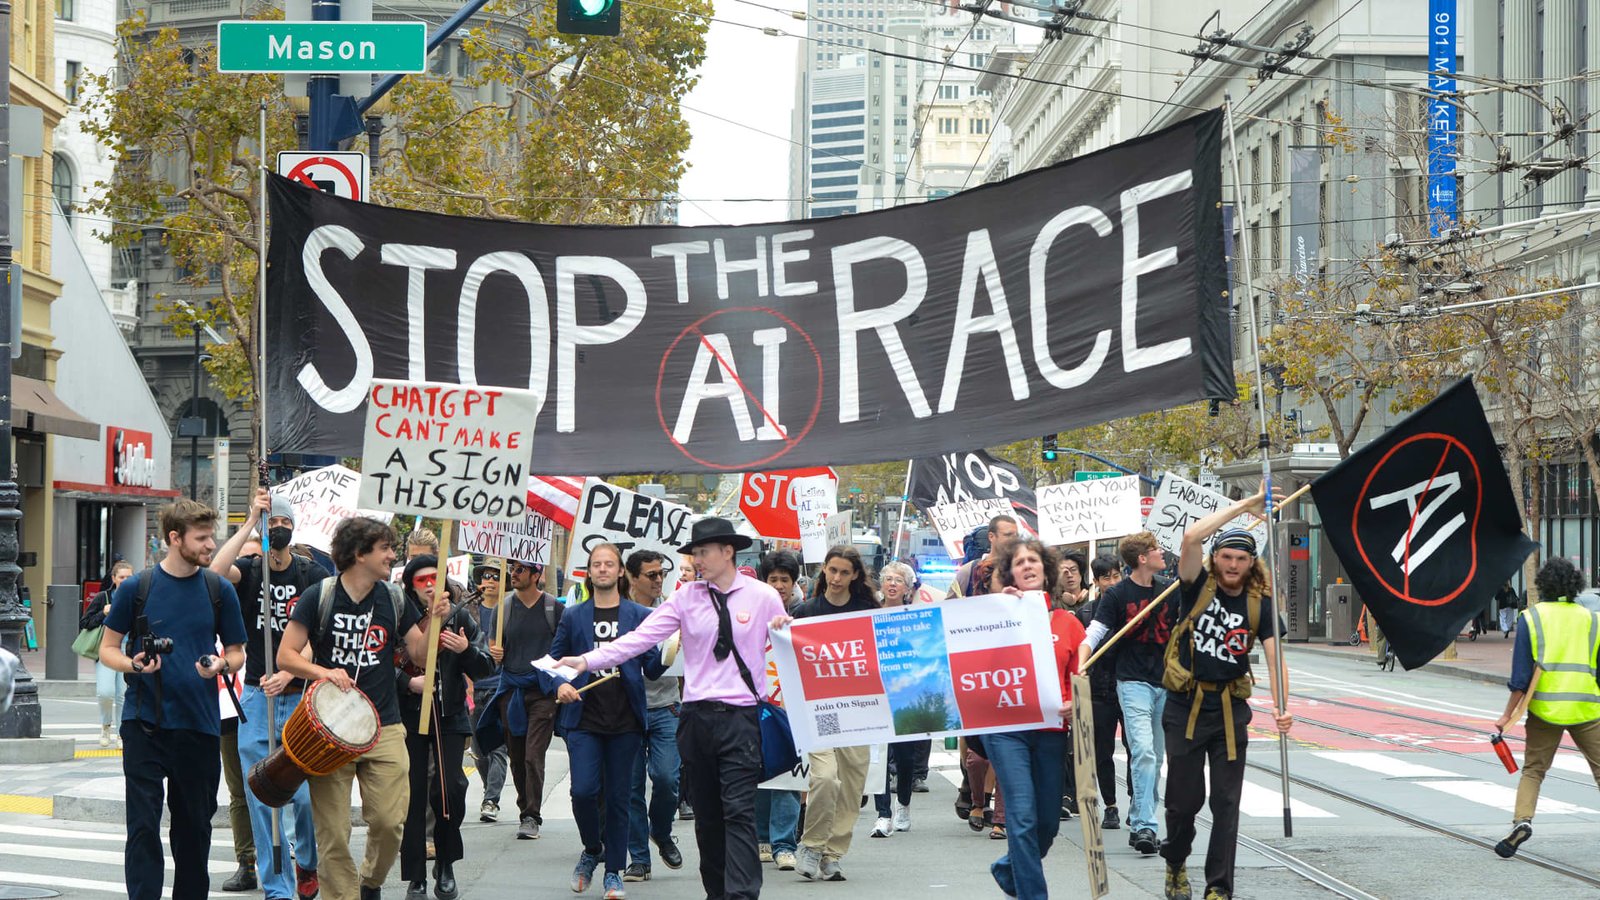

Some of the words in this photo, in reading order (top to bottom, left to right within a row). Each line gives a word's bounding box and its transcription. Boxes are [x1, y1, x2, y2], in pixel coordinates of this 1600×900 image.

[1435, 12, 1450, 45] 901
[268, 35, 376, 60] Mason
[297, 224, 647, 432] STOP
[651, 229, 818, 304] THE
[831, 169, 1195, 425] RACE
[673, 326, 788, 445] AI
[372, 384, 503, 418] CHATGPT
[375, 413, 449, 442] CAN'T
[453, 427, 521, 449] MAKE
[385, 447, 407, 472] A
[425, 449, 522, 486] SIGN
[289, 476, 312, 497] NO
[315, 470, 357, 488] ONE
[744, 473, 798, 511] STO
[1044, 481, 1094, 499] MAY
[1100, 478, 1138, 493] YOUR
[320, 487, 340, 502] IT
[1169, 480, 1218, 513] ENOUGH
[582, 484, 692, 546] PLEASE
[801, 500, 812, 511] AI
[930, 503, 944, 518] IF
[956, 498, 1008, 514] ANYONE
[1040, 496, 1119, 515] TRAINING
[1050, 511, 1103, 524] RUNS
[1369, 471, 1466, 577] AI
[1059, 522, 1118, 538] FAIL
[510, 537, 546, 562] WORK
[1290, 565, 1298, 599] POWELL
[257, 615, 288, 631] RAC
[334, 612, 372, 630] STO
[920, 610, 933, 619] are
[1290, 602, 1298, 632] STREET
[876, 626, 901, 637] trying
[902, 624, 911, 632] to
[913, 621, 931, 631] take
[949, 620, 1022, 636] www.stopai.live
[801, 639, 866, 662] SAVE
[877, 639, 888, 648] all
[890, 637, 899, 647] of
[331, 647, 380, 667] RACE
[880, 650, 895, 660] this
[813, 659, 869, 678] LIFE
[881, 663, 901, 672] from
[960, 667, 1027, 691] STOP
[815, 703, 835, 712] Join
[836, 701, 850, 709] On
[851, 698, 880, 709] Signal
[997, 688, 1026, 708] AI
